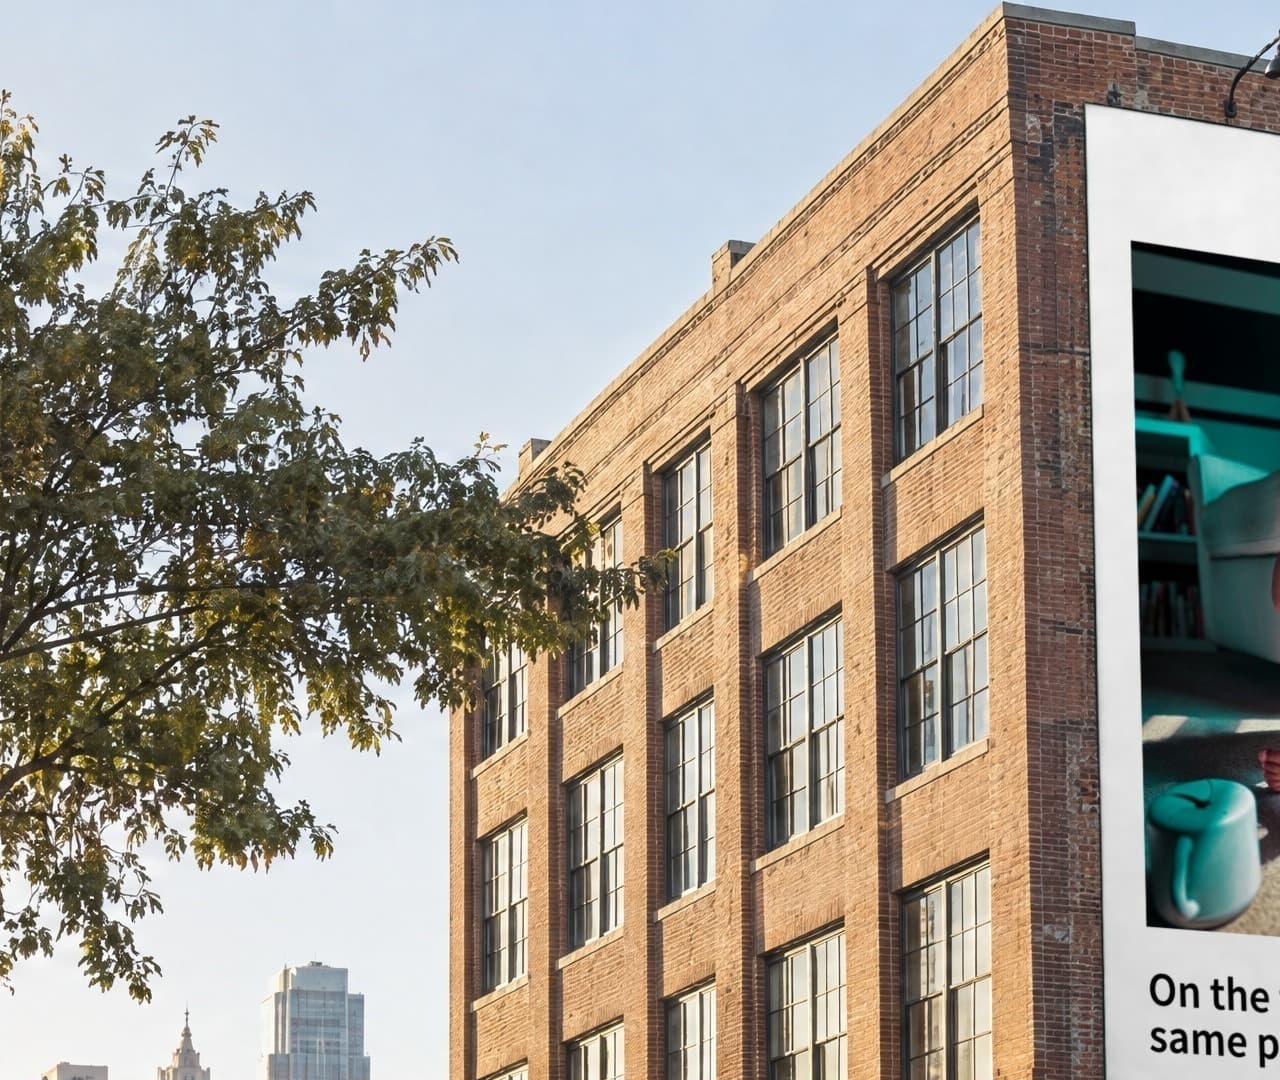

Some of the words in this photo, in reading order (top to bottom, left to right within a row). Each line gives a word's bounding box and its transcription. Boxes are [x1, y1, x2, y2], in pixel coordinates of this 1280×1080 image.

[1149, 973, 1200, 1009] On
[1209, 976, 1270, 1014] the
[1150, 1026, 1248, 1058] same
